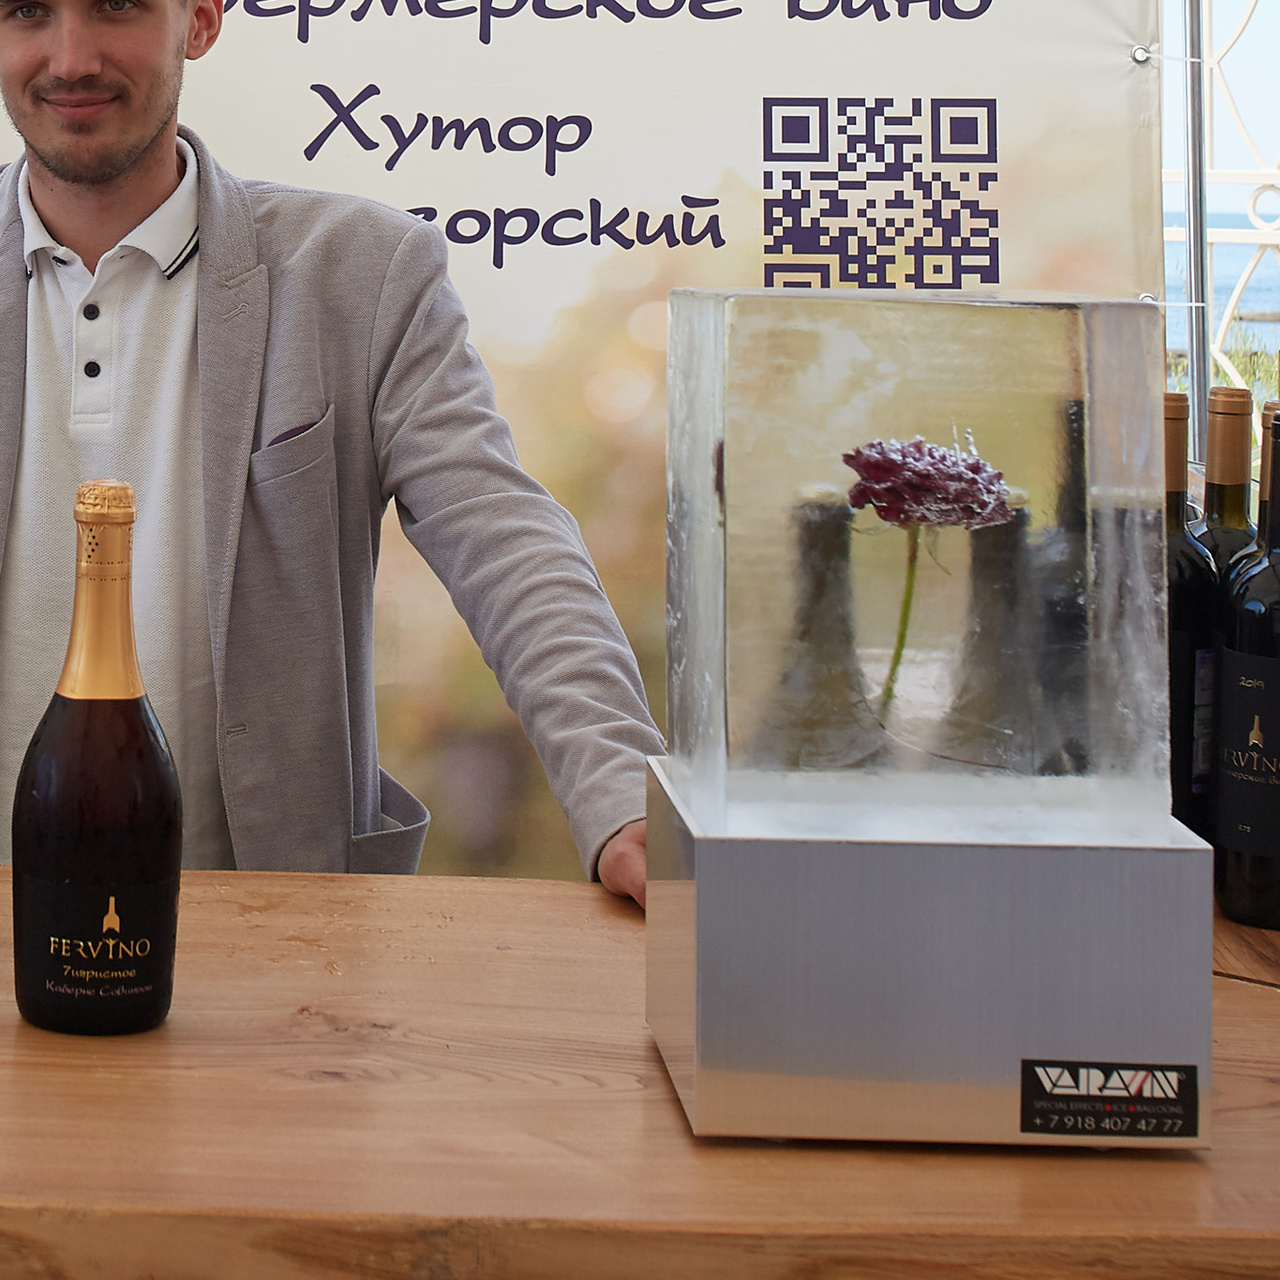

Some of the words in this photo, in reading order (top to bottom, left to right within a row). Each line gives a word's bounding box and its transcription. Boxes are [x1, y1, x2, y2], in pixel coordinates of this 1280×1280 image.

[303, 84, 593, 177] Хутор
[1239, 676, 1265, 690] 2019
[50, 936, 150, 959] FERVINO
[1063, 1115, 1096, 1130] 918
[1100, 1117, 1131, 1131] 407
[1136, 1118, 1157, 1131] 47
[1162, 1119, 1183, 1132] 77
